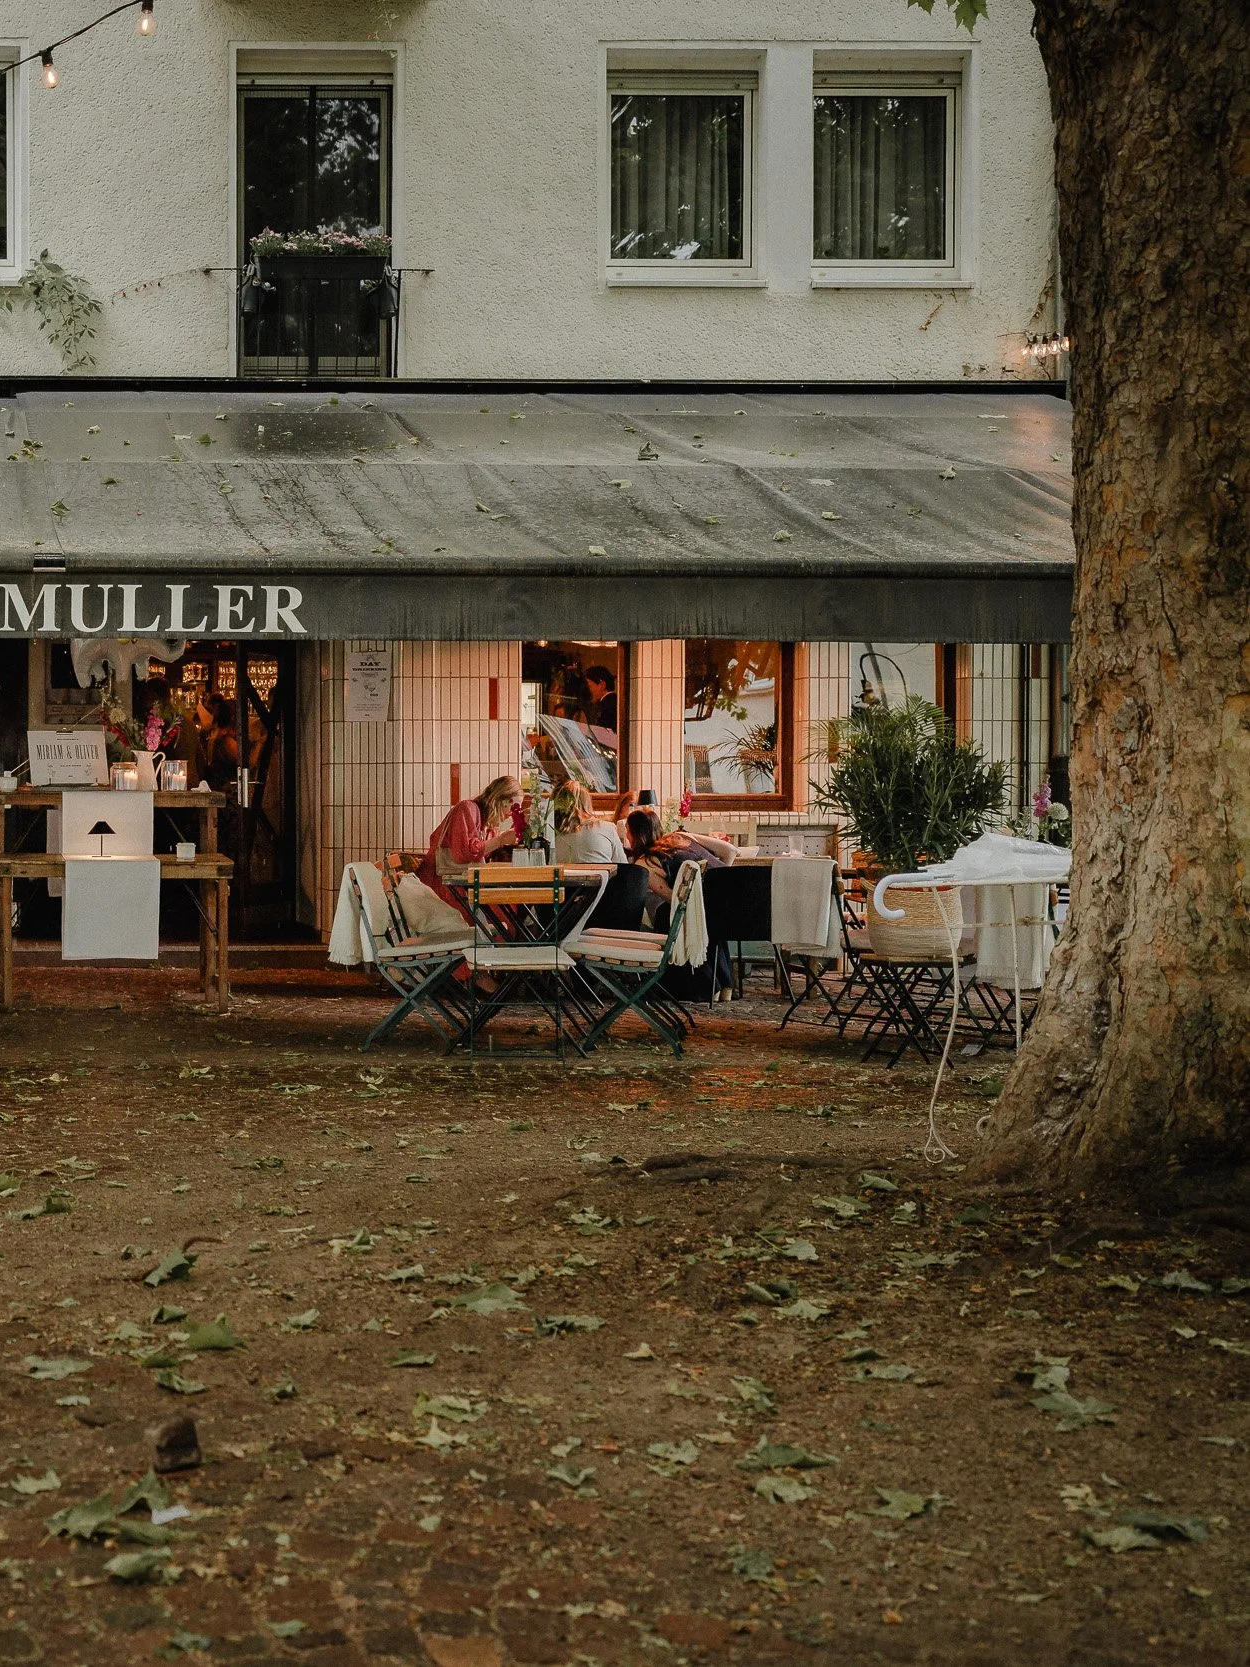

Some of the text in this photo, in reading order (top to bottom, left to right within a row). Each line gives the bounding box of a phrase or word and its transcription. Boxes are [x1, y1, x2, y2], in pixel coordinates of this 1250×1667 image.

[36, 744, 100, 760] MIRIAM & OLIVER
